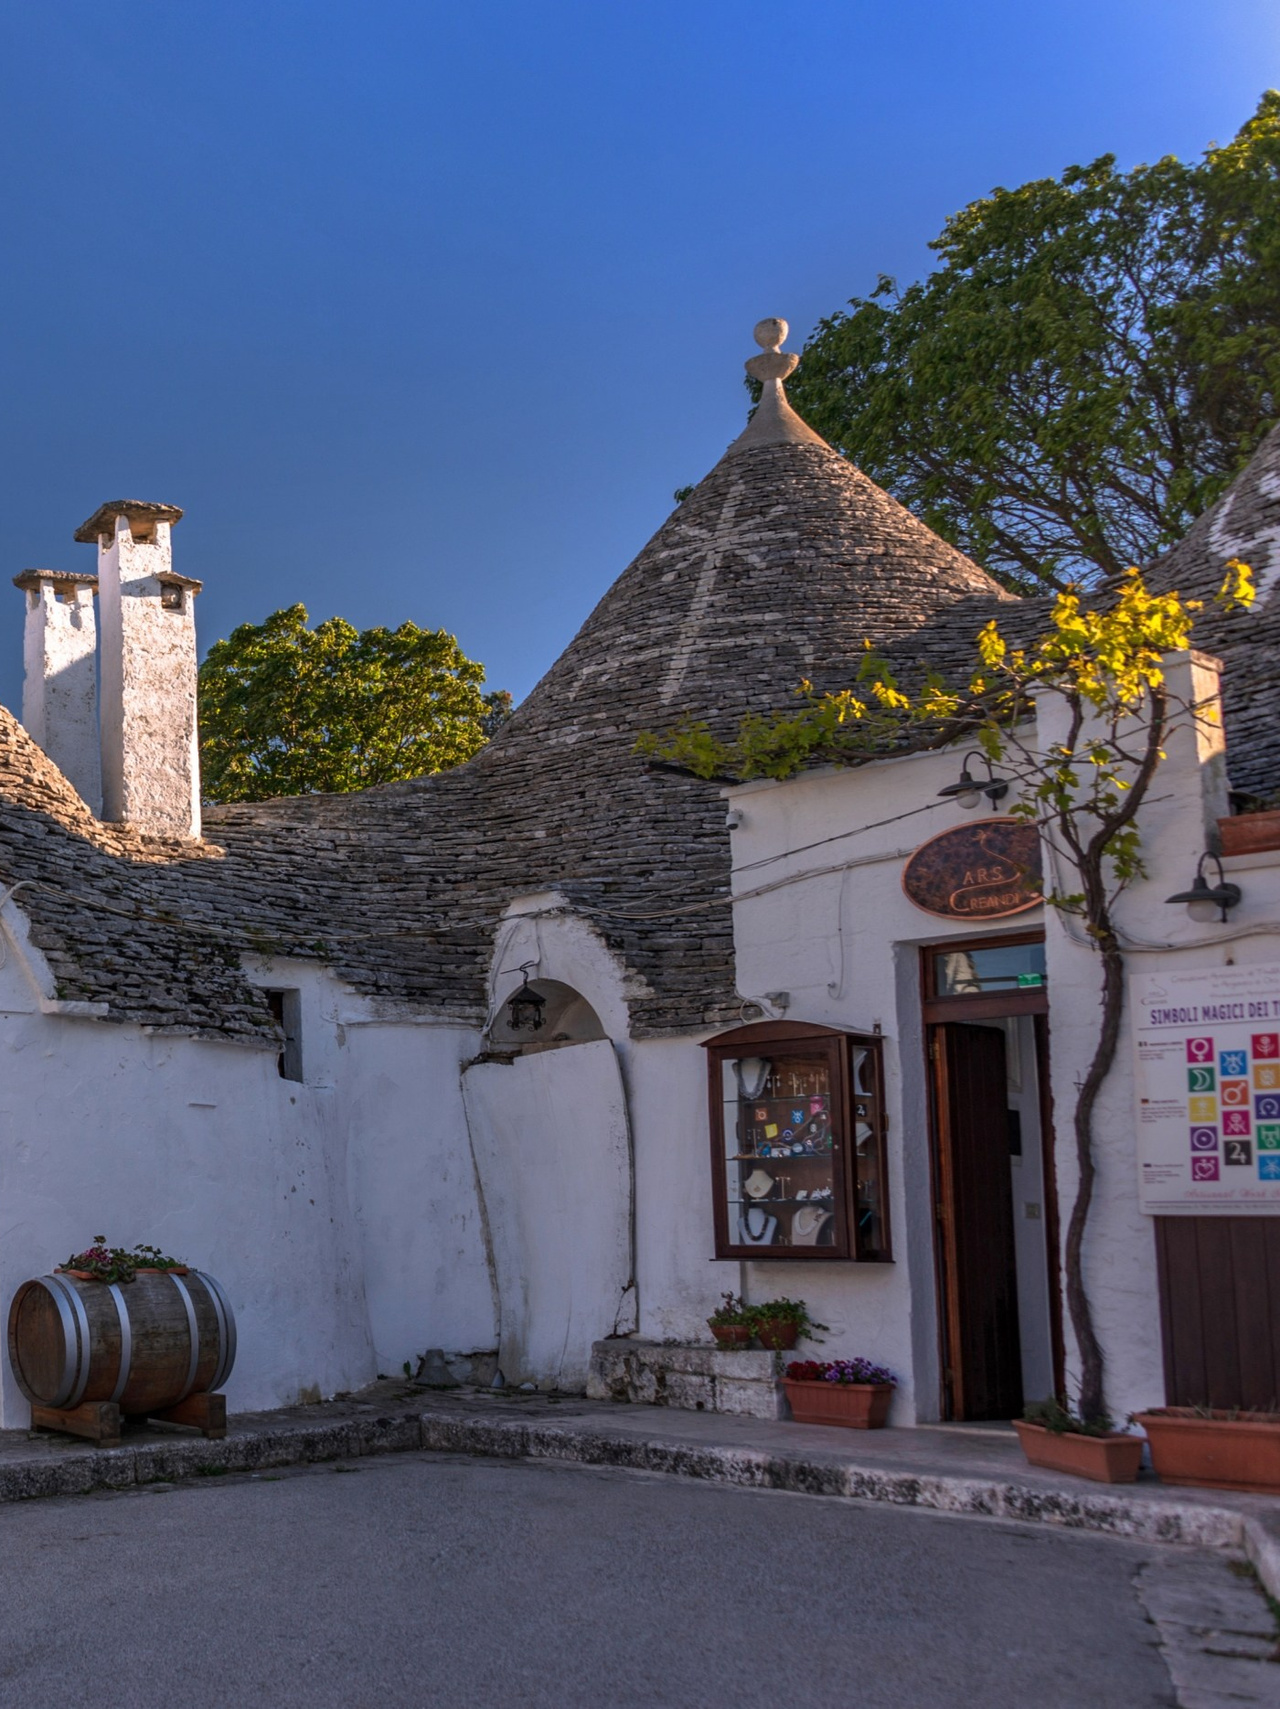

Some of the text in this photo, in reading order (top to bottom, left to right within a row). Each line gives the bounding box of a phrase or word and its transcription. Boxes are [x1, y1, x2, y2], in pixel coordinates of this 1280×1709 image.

[962, 866, 1004, 885] ARS
[1150, 1006, 1198, 1025] SIMBOLI
[1202, 1003, 1244, 1022] MAGICI
[1248, 1001, 1269, 1018] DEI
